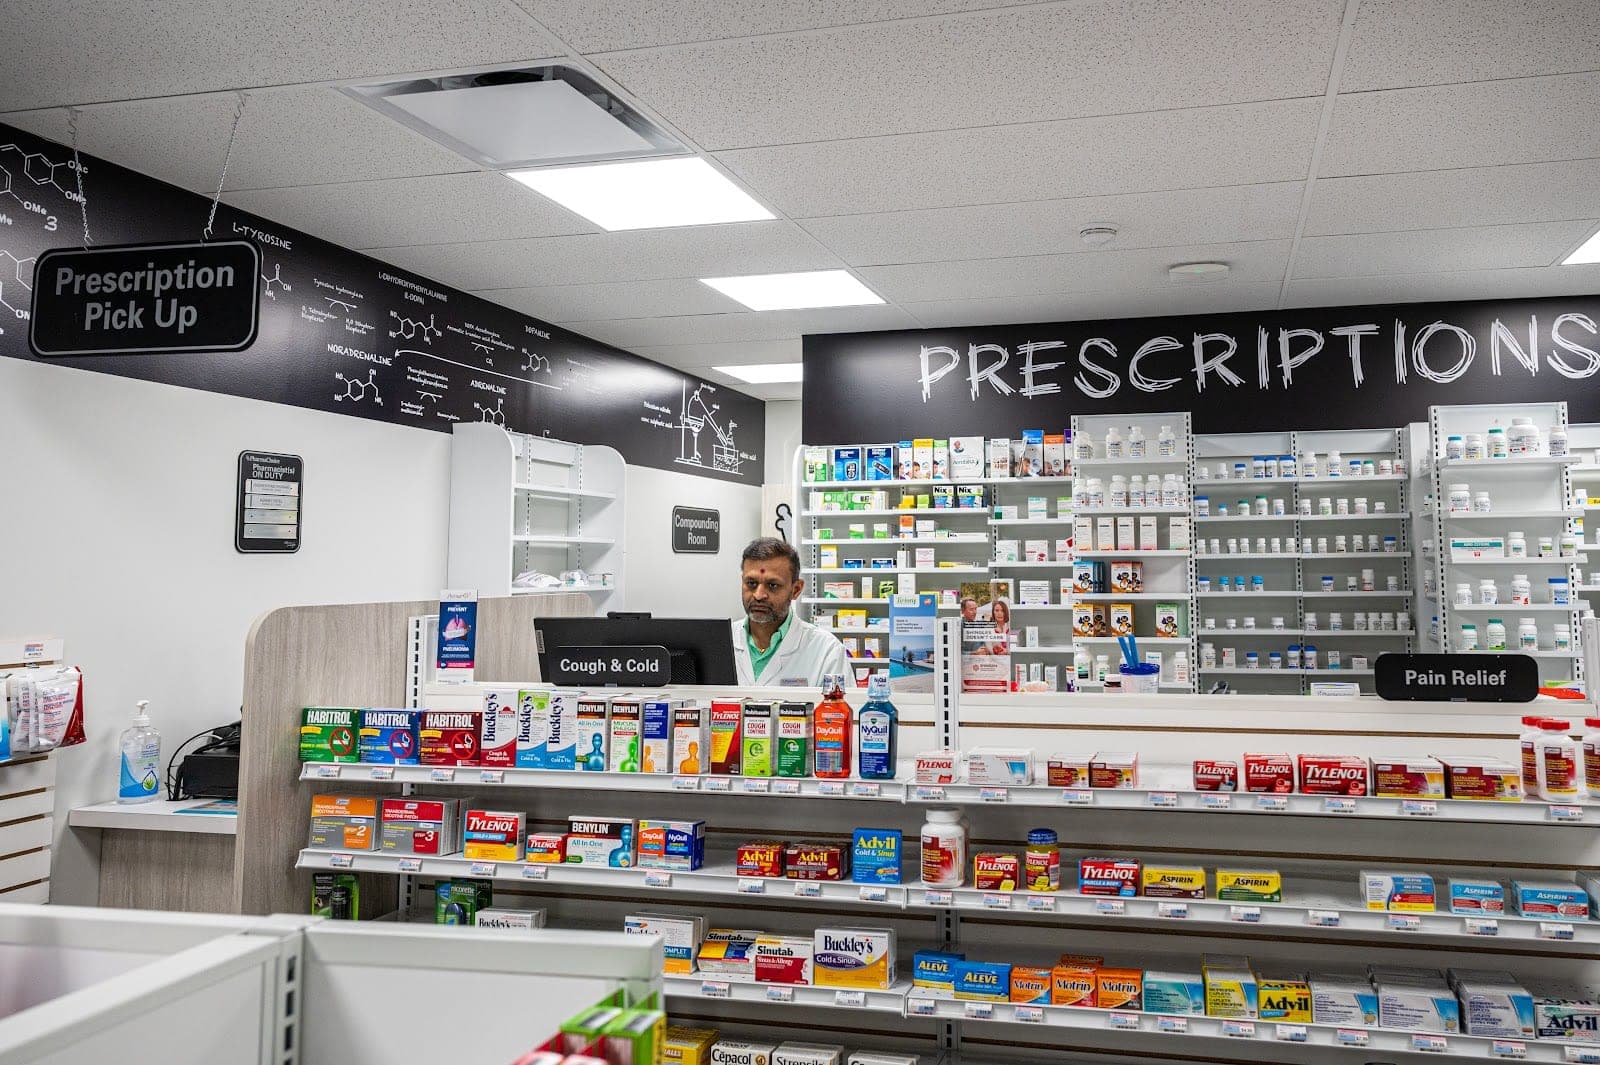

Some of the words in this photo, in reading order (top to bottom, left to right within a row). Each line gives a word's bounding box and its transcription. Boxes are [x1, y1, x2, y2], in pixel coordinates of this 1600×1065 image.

[23, 201, 47, 215] OMe
[44, 215, 57, 231] 3
[232, 222, 292, 250] L-TYROSINE
[55, 260, 235, 298] Prescription
[84, 300, 144, 331] Pick
[154, 298, 198, 334] Up
[327, 343, 392, 367] NORADRENALINE
[917, 312, 1600, 402] PRESCRIPTIONS
[252, 470, 263, 479] ON
[264, 472, 283, 480] DUTY
[675, 514, 719, 532] Compounding
[687, 531, 707, 545] Room
[560, 657, 606, 675] Cough
[610, 658, 622, 673] &
[626, 658, 659, 673] Cold
[1405, 669, 1446, 686] Pain
[1452, 669, 1507, 686] Relief
[578, 704, 604, 713] BENYLIN
[612, 705, 638, 713] BENYLIN
[307, 710, 353, 725] HABITROL
[364, 713, 411, 727] HABITROL
[426, 714, 474, 728] HABITROL
[483, 693, 499, 741] Buckley's
[518, 695, 534, 743] Buckley's
[548, 697, 564, 744] Buckley's
[675, 712, 698, 720] BENYLIN
[712, 711, 740, 720] TYLENOL
[816, 726, 843, 736] DayQuil
[861, 725, 888, 736] NyQuil
[916, 759, 953, 769] TYLENOL
[1197, 764, 1235, 776] TYLENOL
[1248, 763, 1291, 775] TYLENOL
[1305, 764, 1365, 780] TYLENOL
[468, 816, 514, 832] TYLENOL
[571, 822, 610, 835] BENYLIN
[356, 825, 366, 837] 2
[425, 830, 434, 842] 3
[642, 832, 664, 840] DayQuil
[530, 839, 558, 849] TYLENOL
[571, 839, 582, 847] All
[589, 840, 603, 848] One
[668, 834, 688, 842] NyQuil
[855, 836, 896, 849] Advil
[741, 850, 774, 862] Advil
[798, 852, 828, 862] Advil
[854, 848, 870, 856] Cold
[978, 860, 1015, 871] TYLENOL
[1082, 865, 1136, 880] TYLENOL
[1159, 875, 1194, 884] ASPIRIN
[1233, 877, 1270, 886] ASPIRIN
[451, 886, 474, 894] nicorette
[1463, 887, 1494, 895] ASPIRIN
[1536, 892, 1568, 900] ASPIRIN
[707, 933, 743, 941] Sinutab
[757, 945, 794, 956] Sinutab
[824, 935, 873, 955] Buckley's
[776, 957, 793, 966] Allergy
[816, 955, 832, 963] Cold
[838, 957, 856, 965] Sinus
[918, 960, 949, 972] ALEVE
[963, 972, 998, 984] ALEVE
[1014, 980, 1044, 990] Motrin
[1056, 978, 1091, 991] Motrin
[1102, 981, 1137, 993] Motrin
[1262, 996, 1310, 1011] Advil
[1547, 1015, 1598, 1030] Advil
